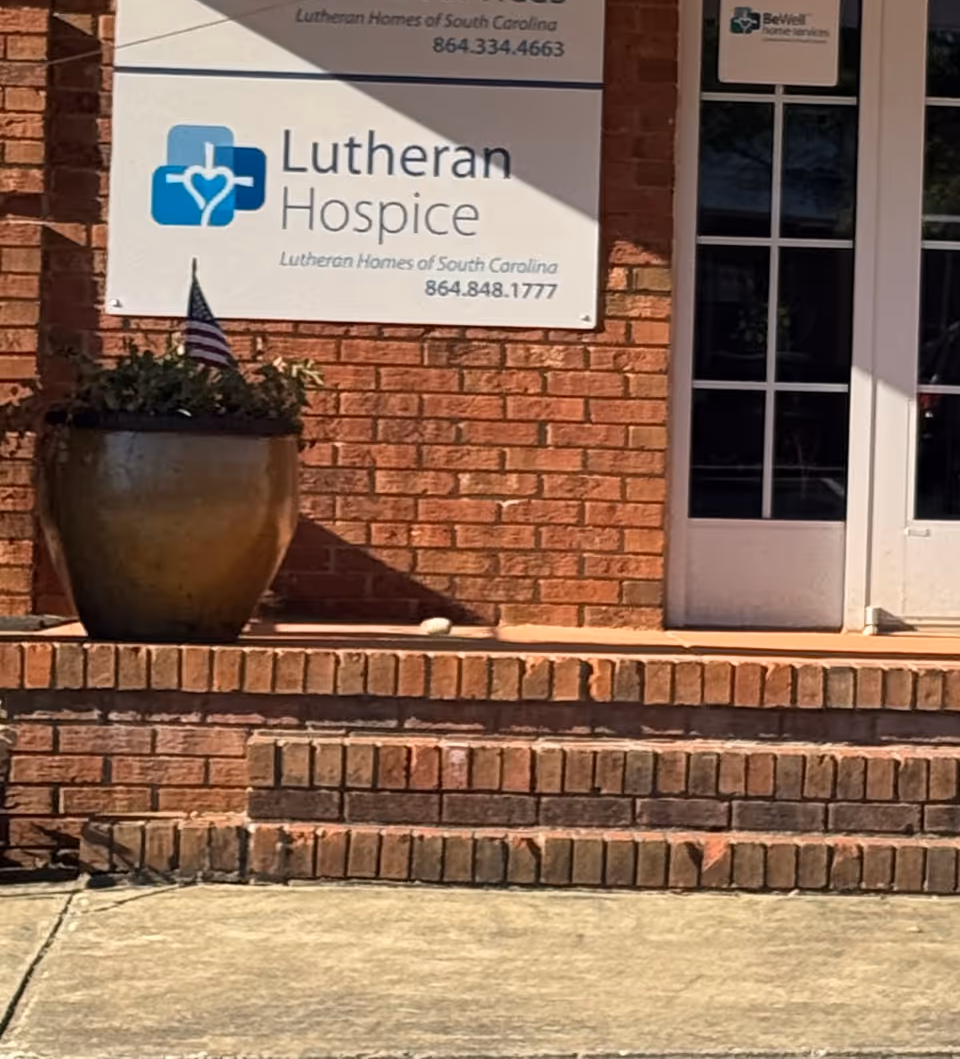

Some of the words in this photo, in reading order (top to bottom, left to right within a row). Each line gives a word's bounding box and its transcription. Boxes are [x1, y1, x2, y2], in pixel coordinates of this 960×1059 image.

[295, 7, 365, 26] Lutheran
[367, 10, 421, 28] Homes
[425, 12, 443, 29] of
[444, 12, 489, 30] South
[492, 14, 558, 32] Carolina
[763, 12, 806, 25] BeWell
[432, 36, 565, 58] 864.334.4663
[282, 128, 512, 179] Lutheran
[281, 185, 480, 245] Hospice
[279, 250, 354, 269] Lutheran
[356, 253, 414, 271] Homes
[417, 254, 436, 272] of
[436, 255, 485, 273] South
[488, 257, 559, 275] Carolina
[424, 279, 559, 300] 864.848.1777
